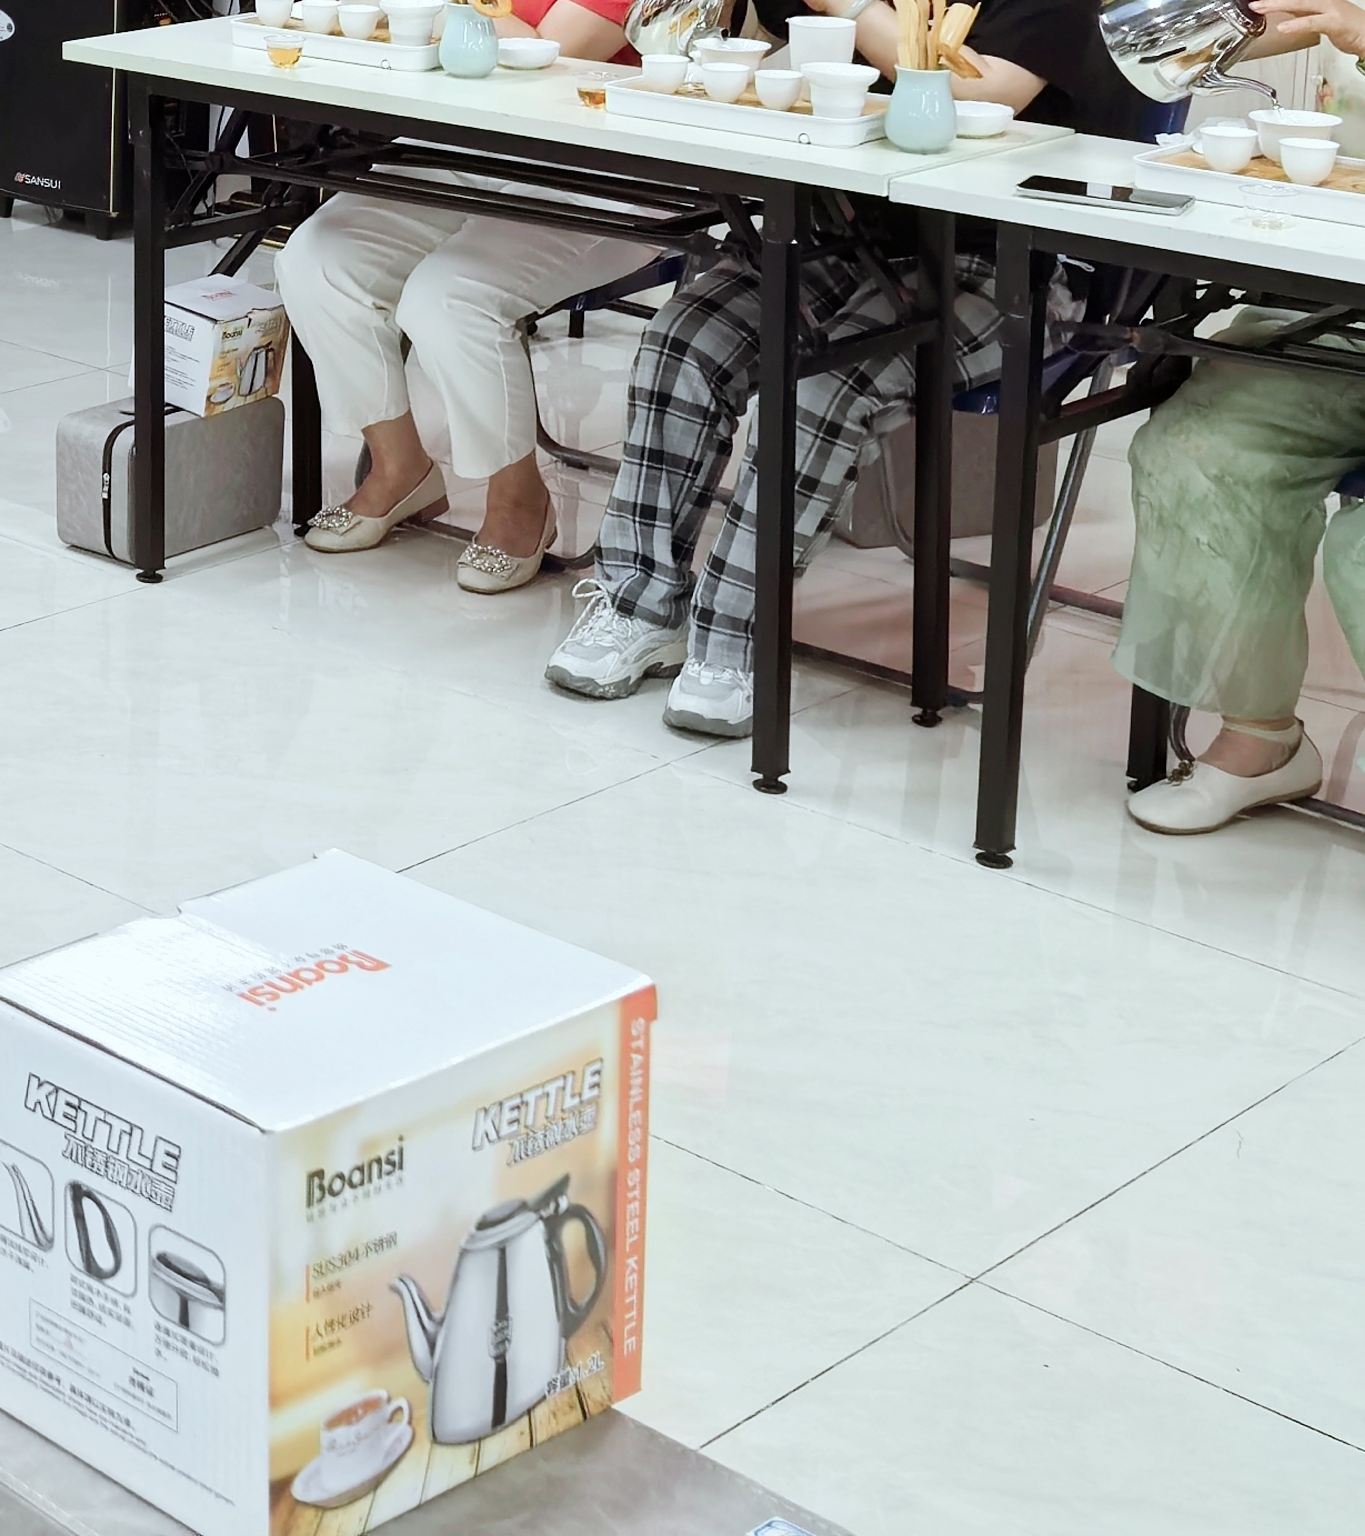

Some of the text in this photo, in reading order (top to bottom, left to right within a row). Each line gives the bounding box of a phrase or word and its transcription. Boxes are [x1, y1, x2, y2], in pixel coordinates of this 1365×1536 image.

[24, 174, 61, 190] SANSUI
[236, 949, 392, 1012] Boansi
[24, 1072, 181, 1184] KETTLE
[472, 1057, 604, 1152] KETTLE
[306, 1134, 404, 1209] Boansi
[623, 1017, 645, 1358] STAINLESS STEEL KETTLE
